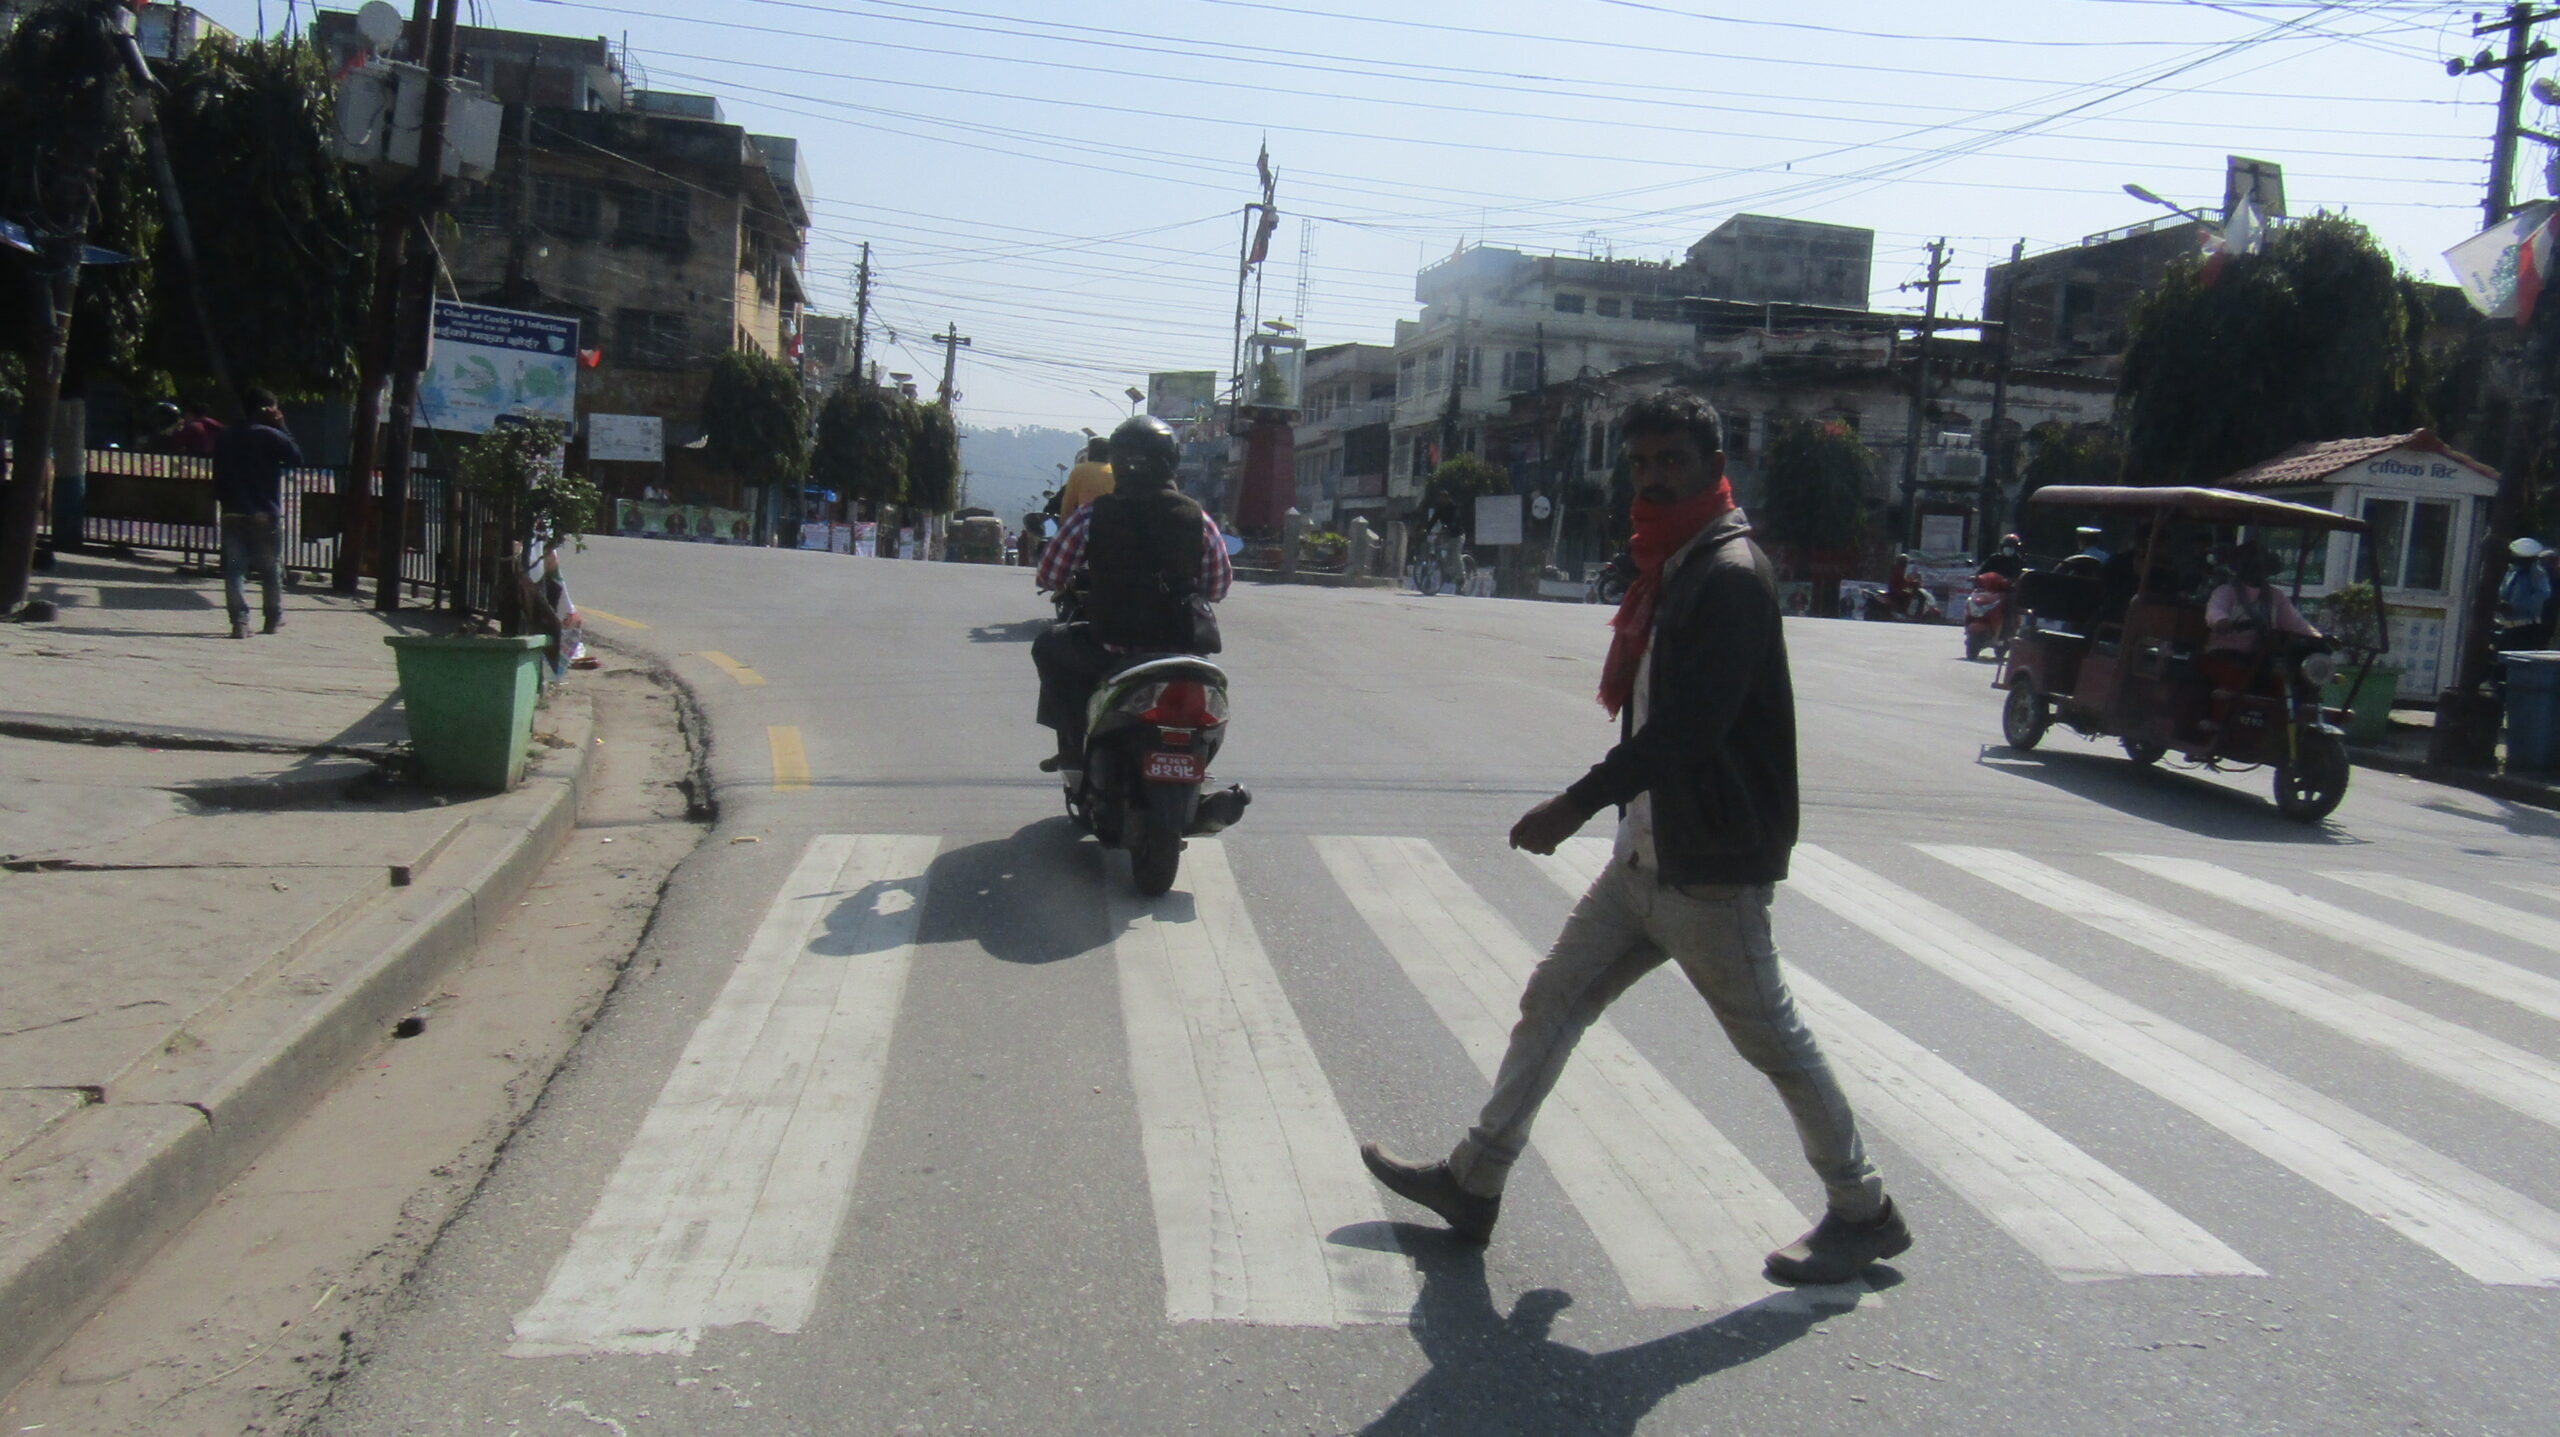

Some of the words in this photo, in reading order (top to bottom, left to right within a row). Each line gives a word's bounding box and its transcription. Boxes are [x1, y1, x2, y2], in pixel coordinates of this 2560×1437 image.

[443, 309, 469, 318] Chain
[472, 312, 481, 321] of
[527, 321, 567, 333] Infection
